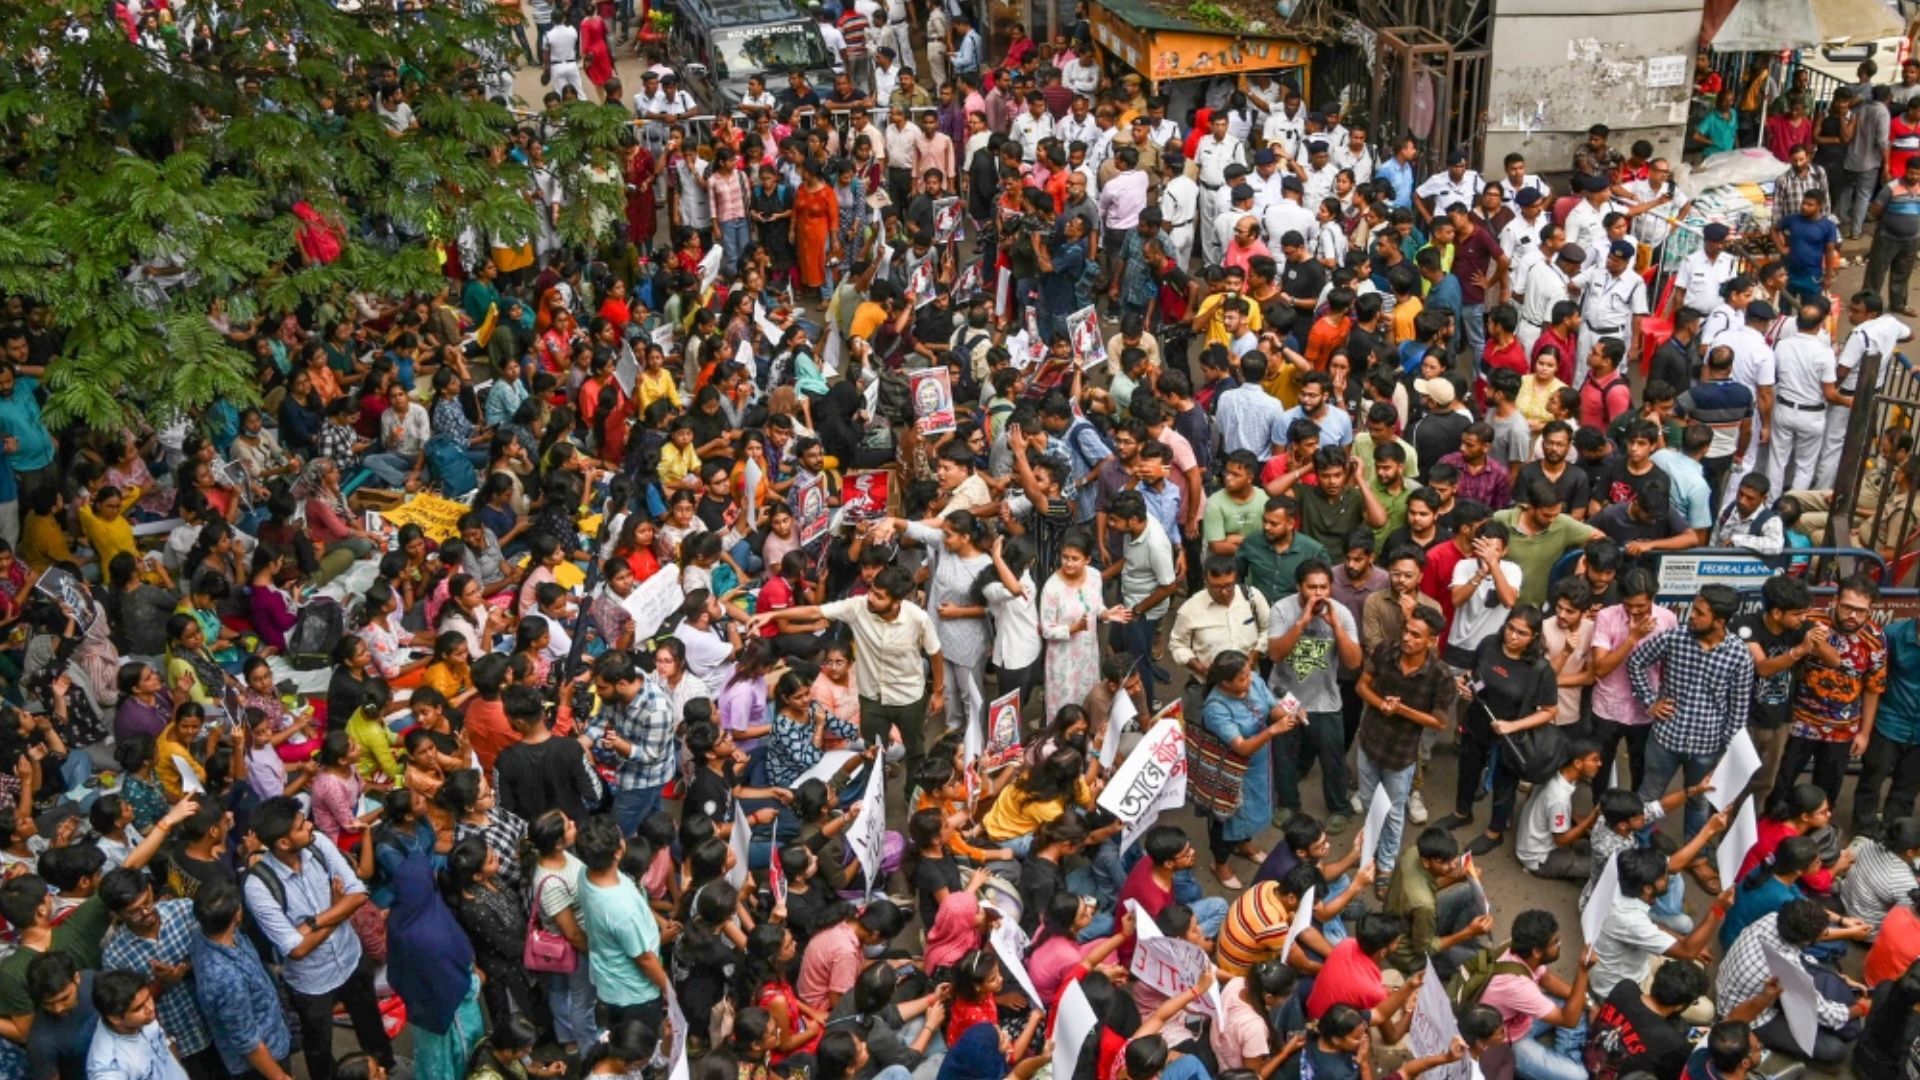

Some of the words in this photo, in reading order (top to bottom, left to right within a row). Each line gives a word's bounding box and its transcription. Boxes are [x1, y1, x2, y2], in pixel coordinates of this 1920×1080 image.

[771, 25, 803, 34] POLICE
[1702, 564, 1741, 573] FEDERAL
[1554, 813, 1566, 827] 3
